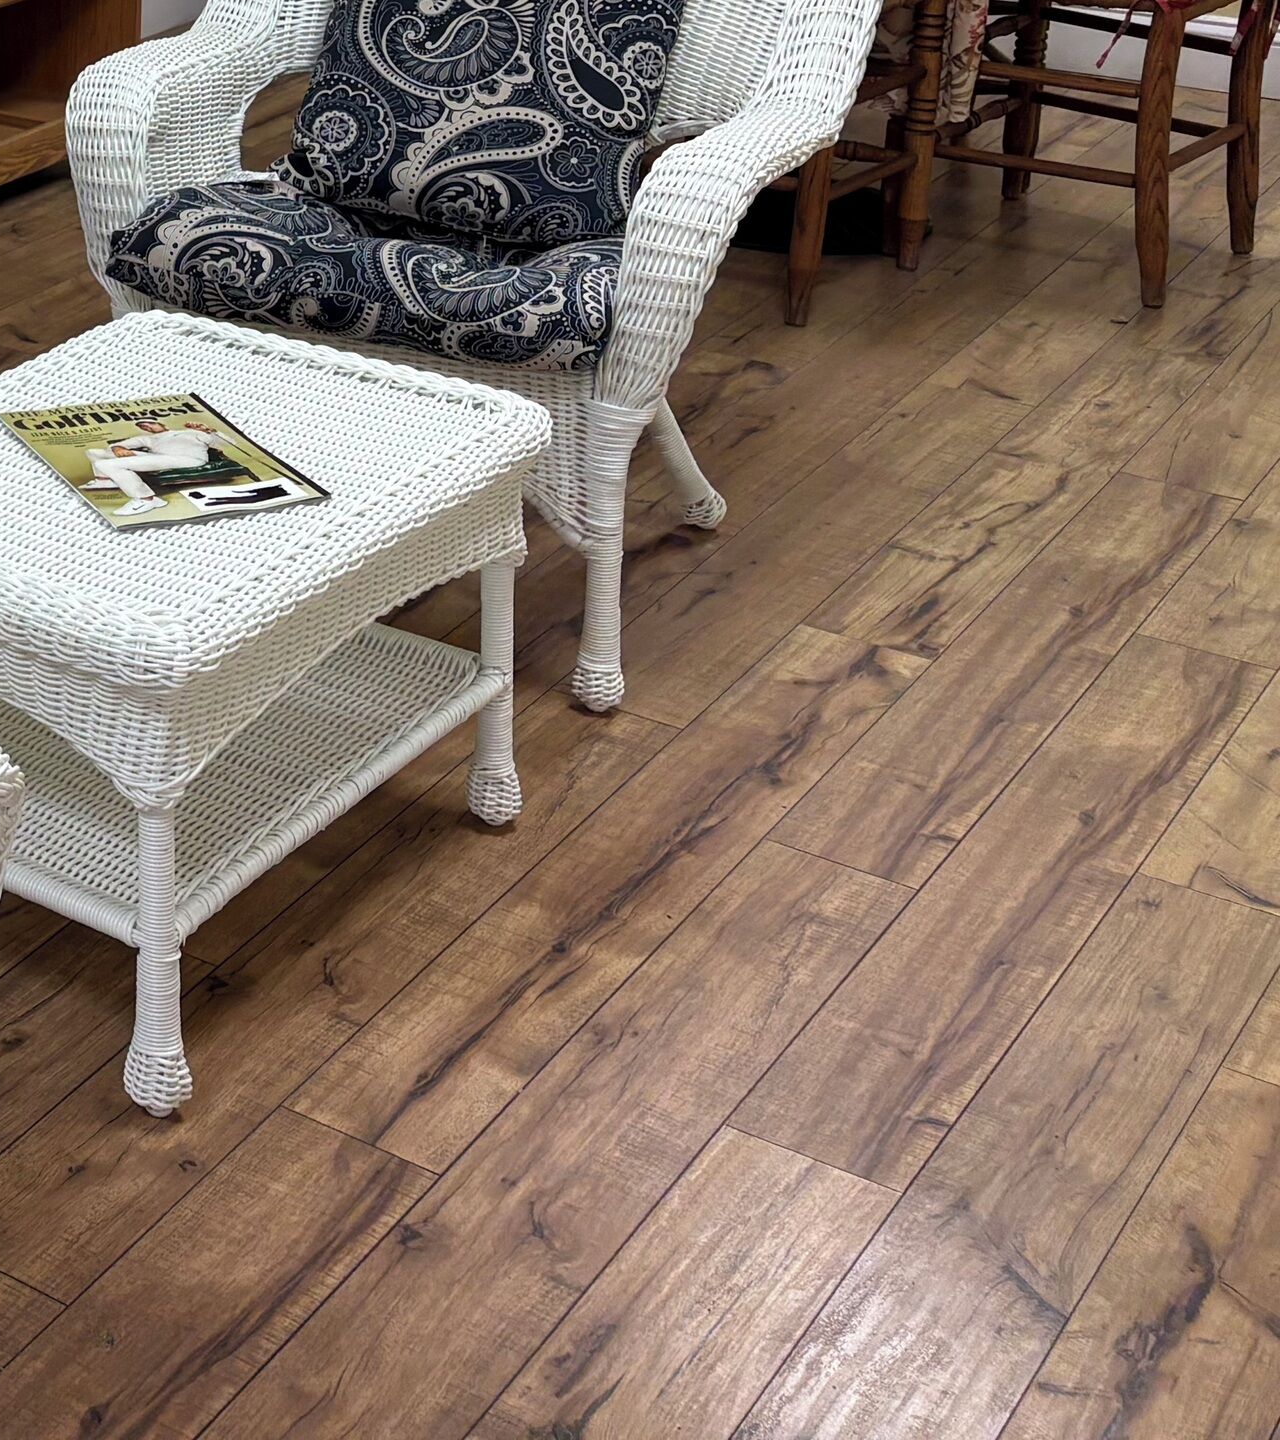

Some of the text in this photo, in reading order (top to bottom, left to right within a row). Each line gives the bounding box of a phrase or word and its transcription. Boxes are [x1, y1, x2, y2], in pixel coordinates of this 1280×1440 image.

[13, 402, 203, 431] Golf Digest
[47, 400, 131, 416] MASTERS
[133, 396, 186, 408] ISSUE
